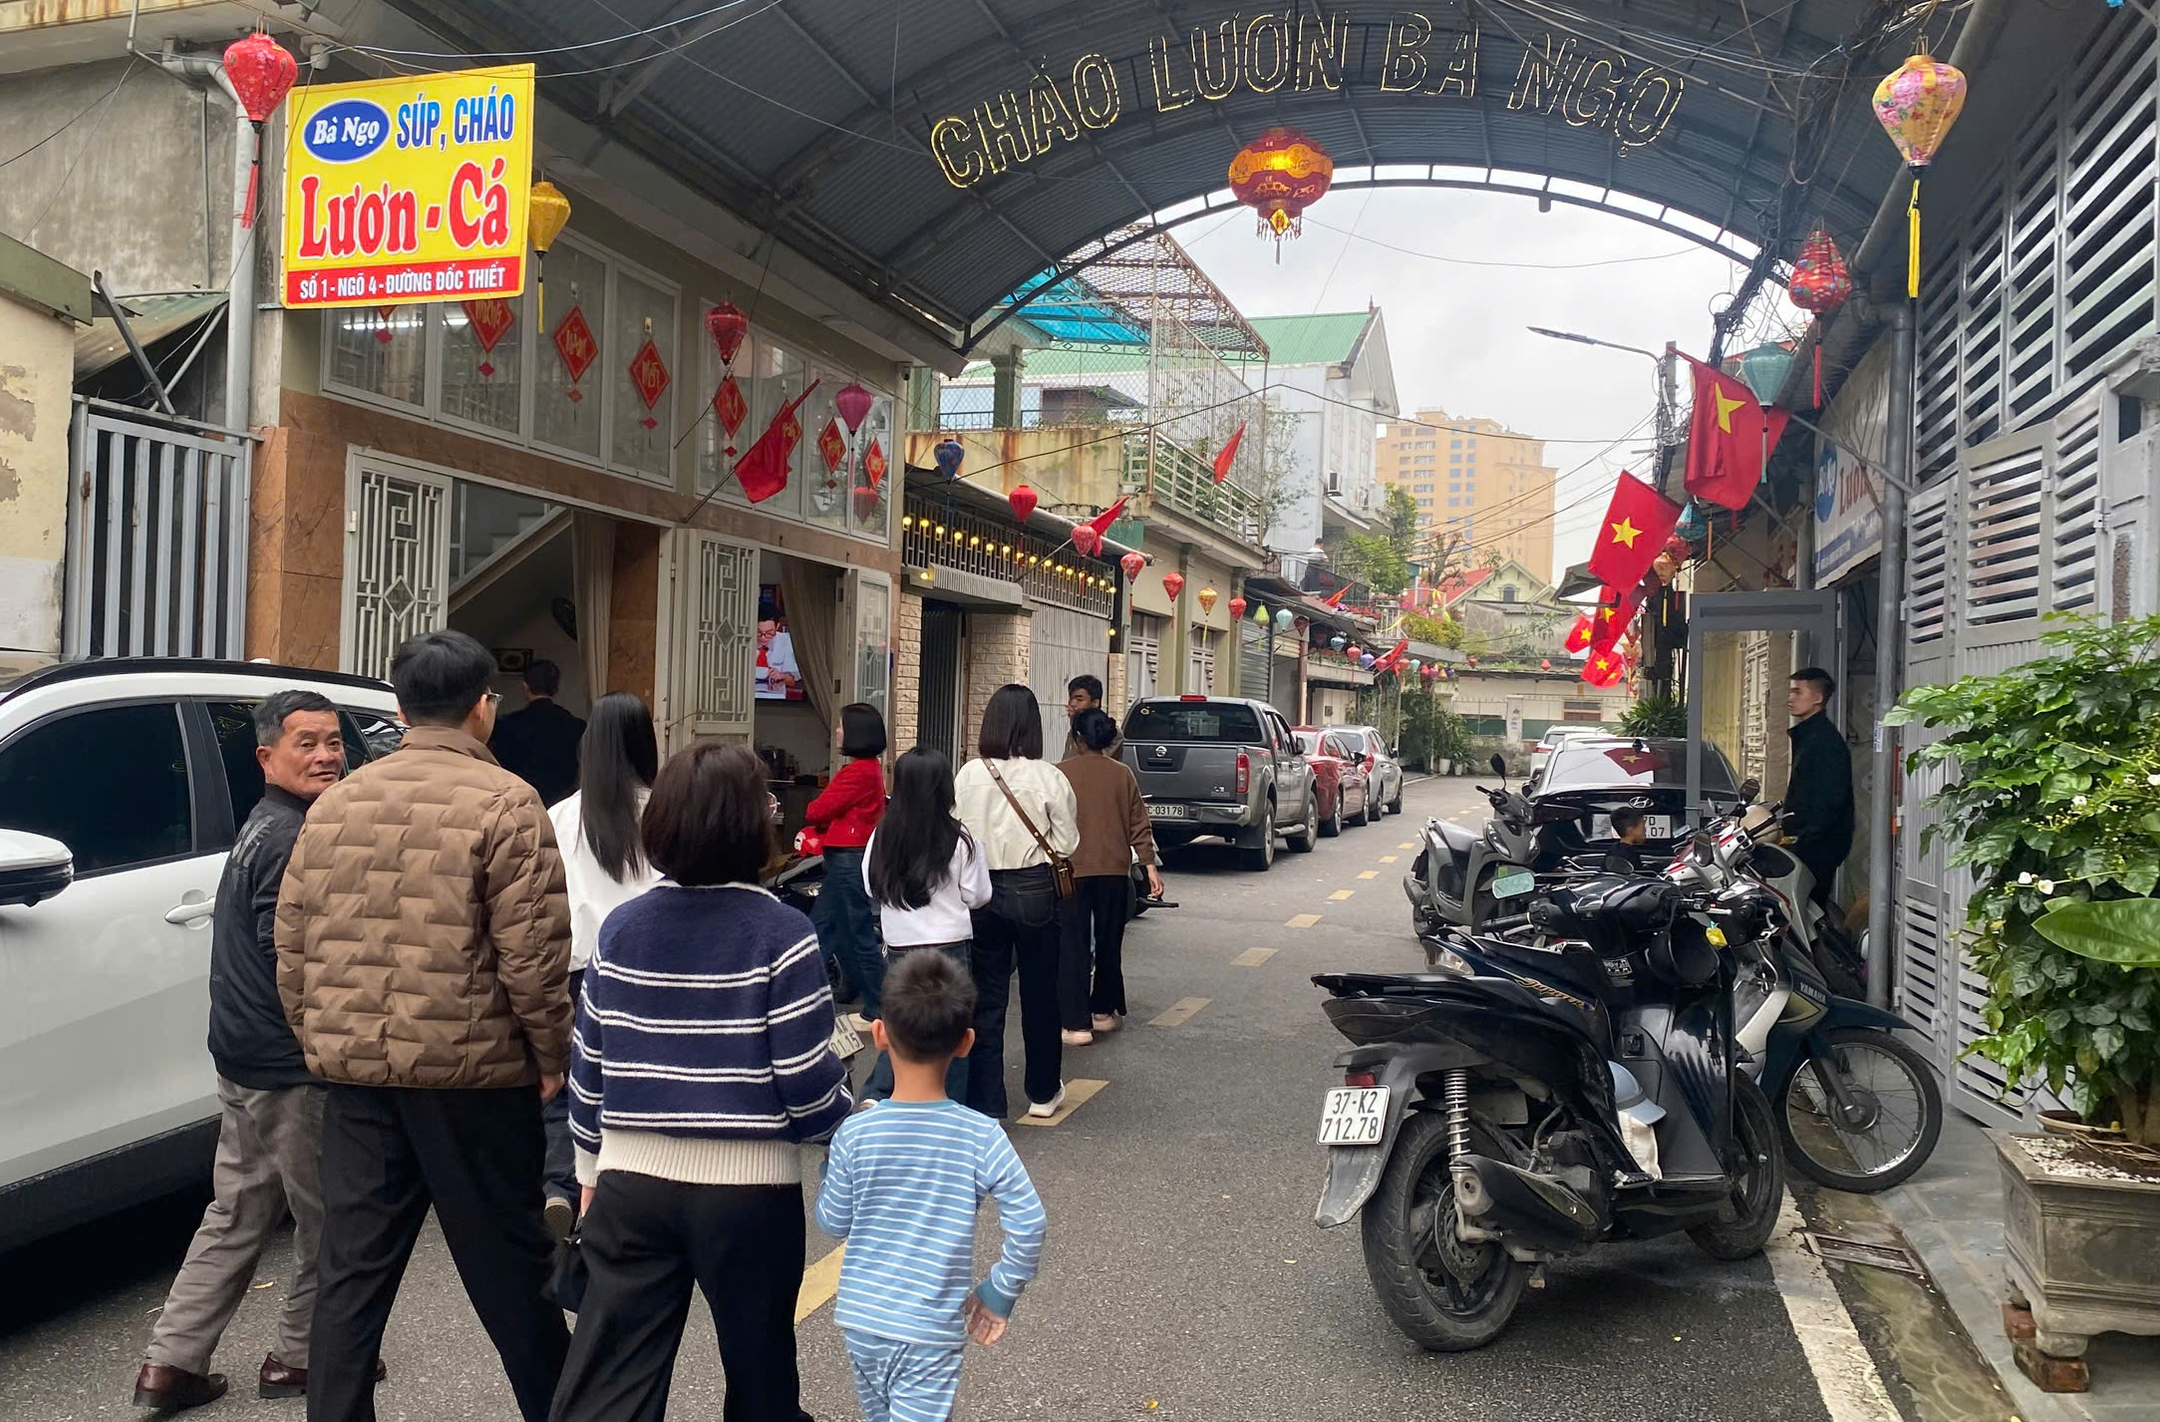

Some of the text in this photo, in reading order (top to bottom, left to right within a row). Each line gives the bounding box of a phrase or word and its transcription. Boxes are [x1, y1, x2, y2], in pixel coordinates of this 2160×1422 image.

[396, 85, 516, 151] SÚP, CHÁO
[930, 53, 1121, 189] CHÁO
[1506, 32, 1686, 158] NGỌ
[312, 115, 381, 147] Bà Ngọ
[298, 175, 419, 259] Lươn
[448, 156, 510, 250] Cá
[300, 272, 318, 299] SỐ
[435, 262, 464, 291] ĐỐC
[467, 260, 506, 289] THIẾT
[1332, 1090, 1378, 1115] 37-K2
[1322, 1116, 1379, 1141] 712.78
